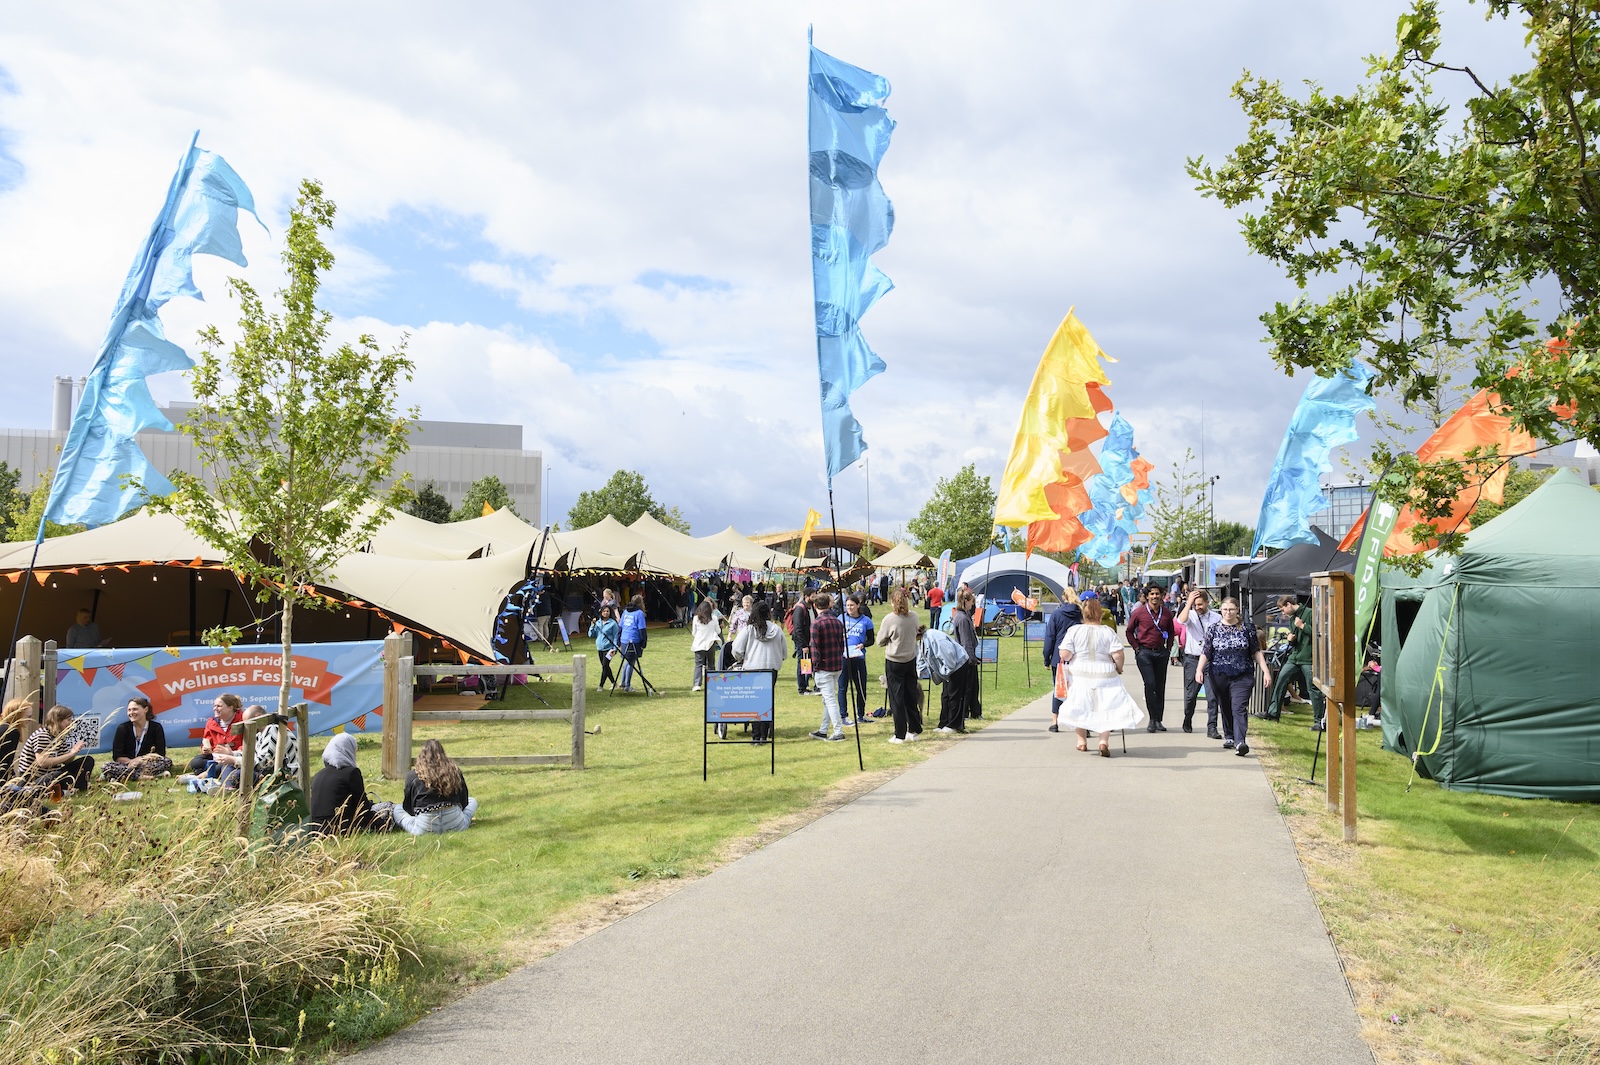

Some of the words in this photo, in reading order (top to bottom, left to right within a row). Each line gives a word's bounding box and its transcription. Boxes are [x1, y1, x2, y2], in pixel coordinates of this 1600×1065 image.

[189, 660, 218, 672] The
[222, 656, 297, 669] Cambride
[164, 672, 247, 695] Wellness
[252, 669, 319, 688] Fesival
[250, 694, 292, 703] Septemr
